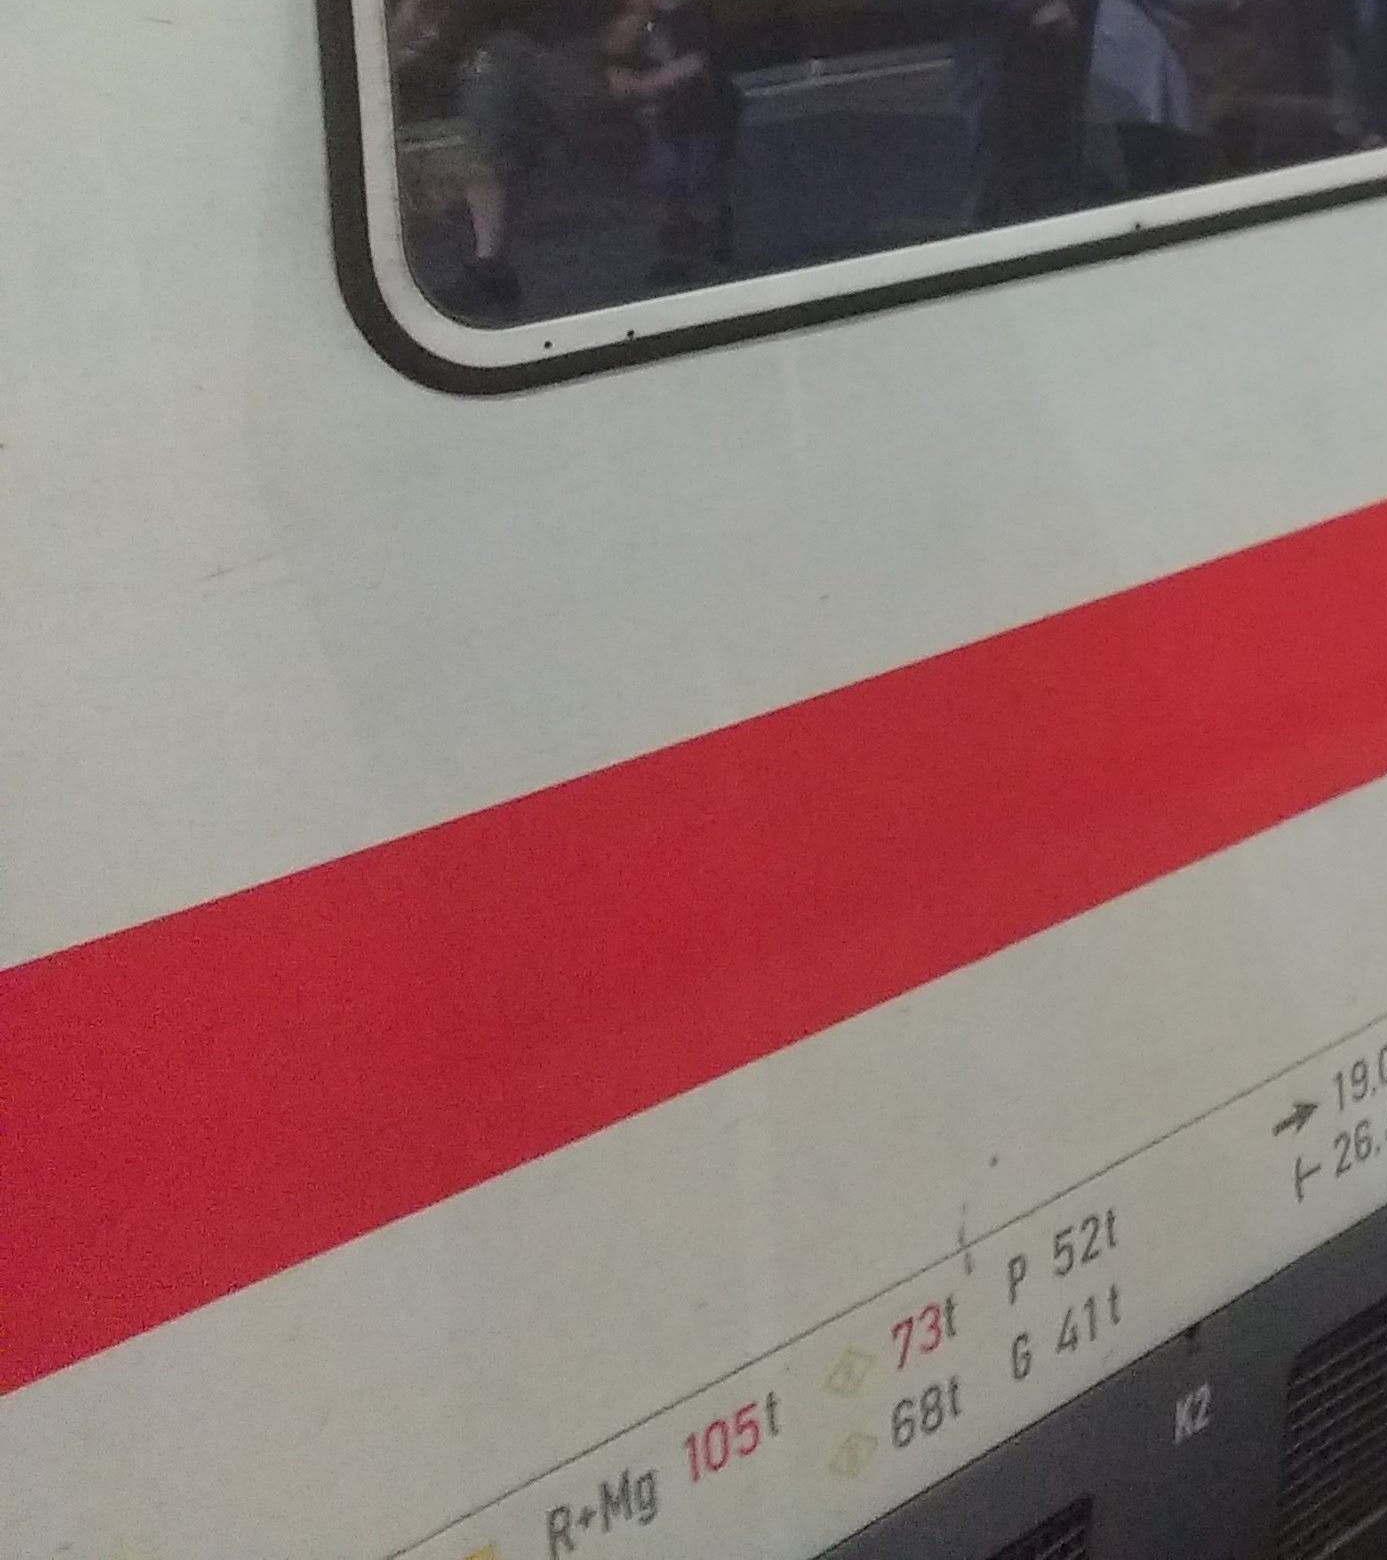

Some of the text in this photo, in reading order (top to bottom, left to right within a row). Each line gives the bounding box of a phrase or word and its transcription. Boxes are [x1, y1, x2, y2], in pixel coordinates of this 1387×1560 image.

[891, 1207, 1117, 1370] 73t P 52t
[891, 1283, 1122, 1448] 68t G 41t
[544, 1391, 780, 1560] R+Mg 105t
